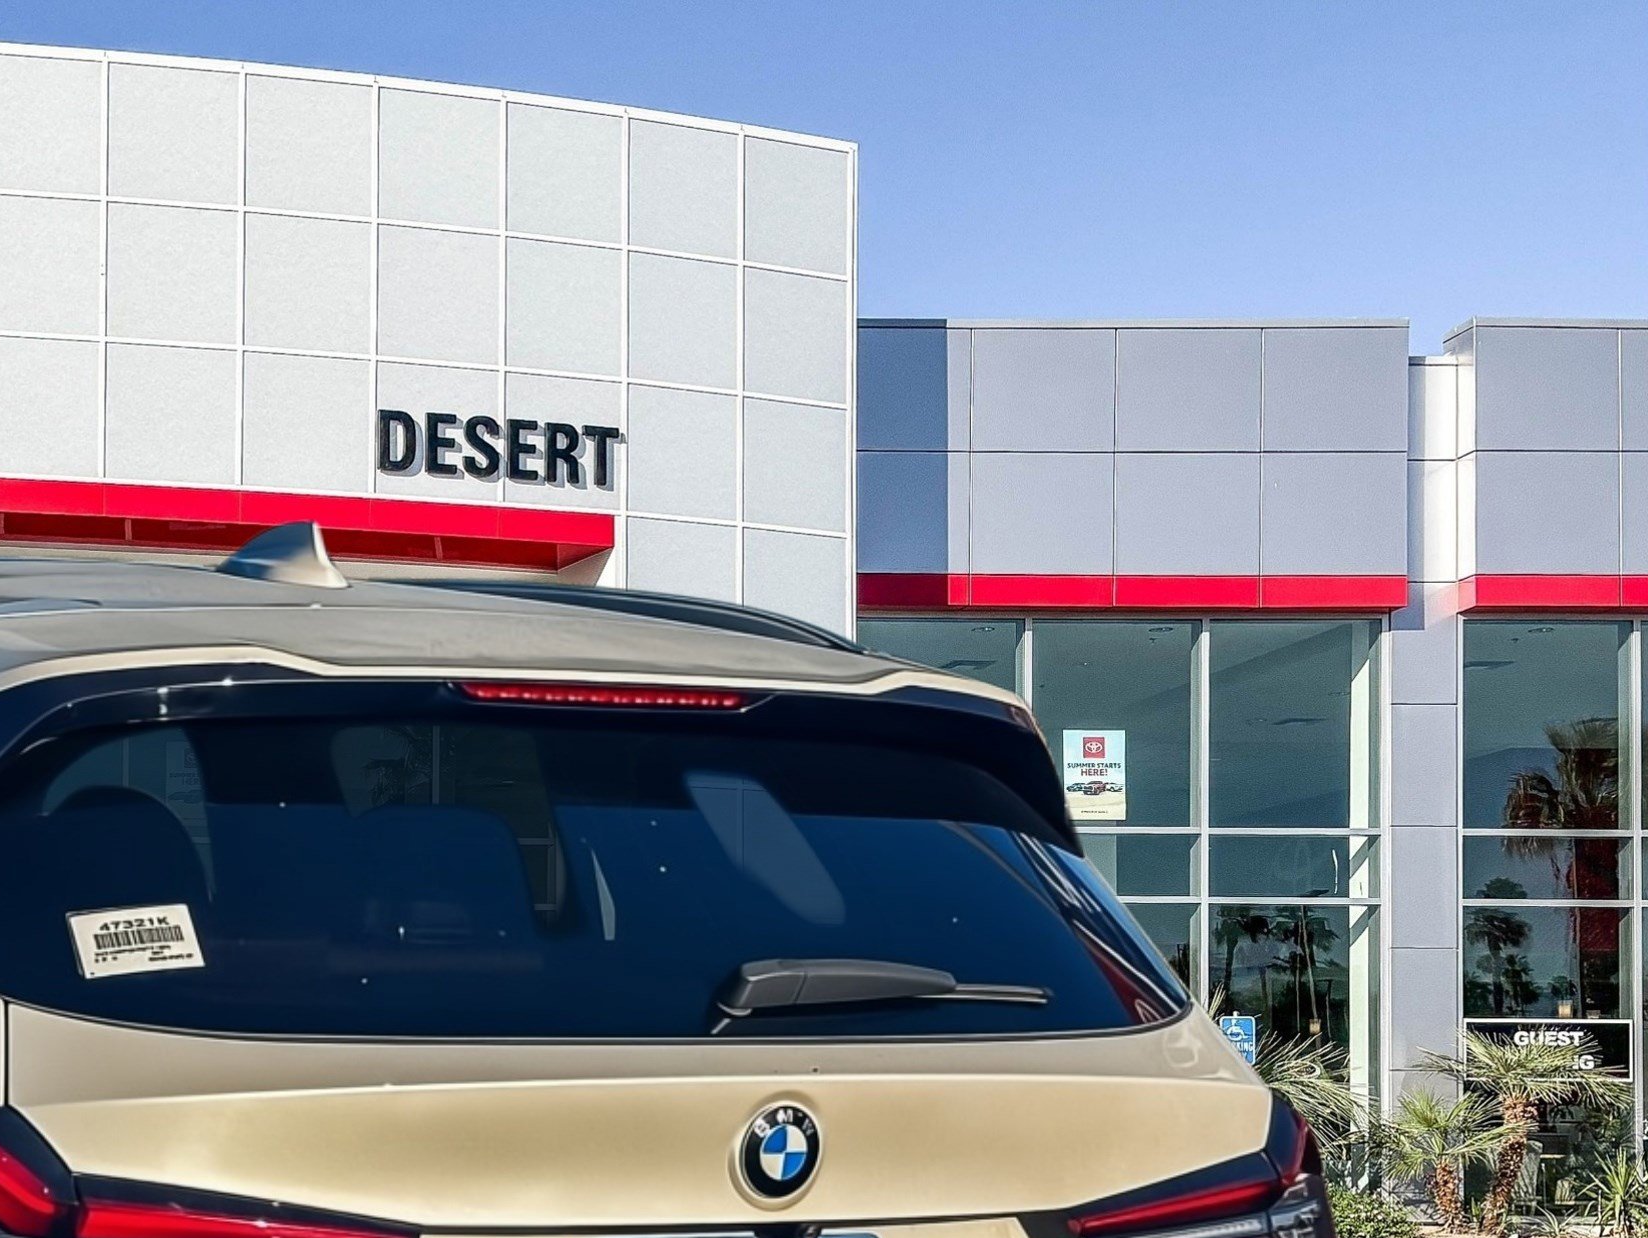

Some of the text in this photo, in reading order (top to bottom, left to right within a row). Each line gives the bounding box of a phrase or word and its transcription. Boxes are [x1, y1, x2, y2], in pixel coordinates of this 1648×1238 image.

[377, 409, 620, 487] DESERT
[1080, 768, 1108, 777] HERE!
[99, 916, 170, 931] 47321K
[1513, 1031, 1584, 1047] GUEST
[753, 1108, 814, 1138] BMW
